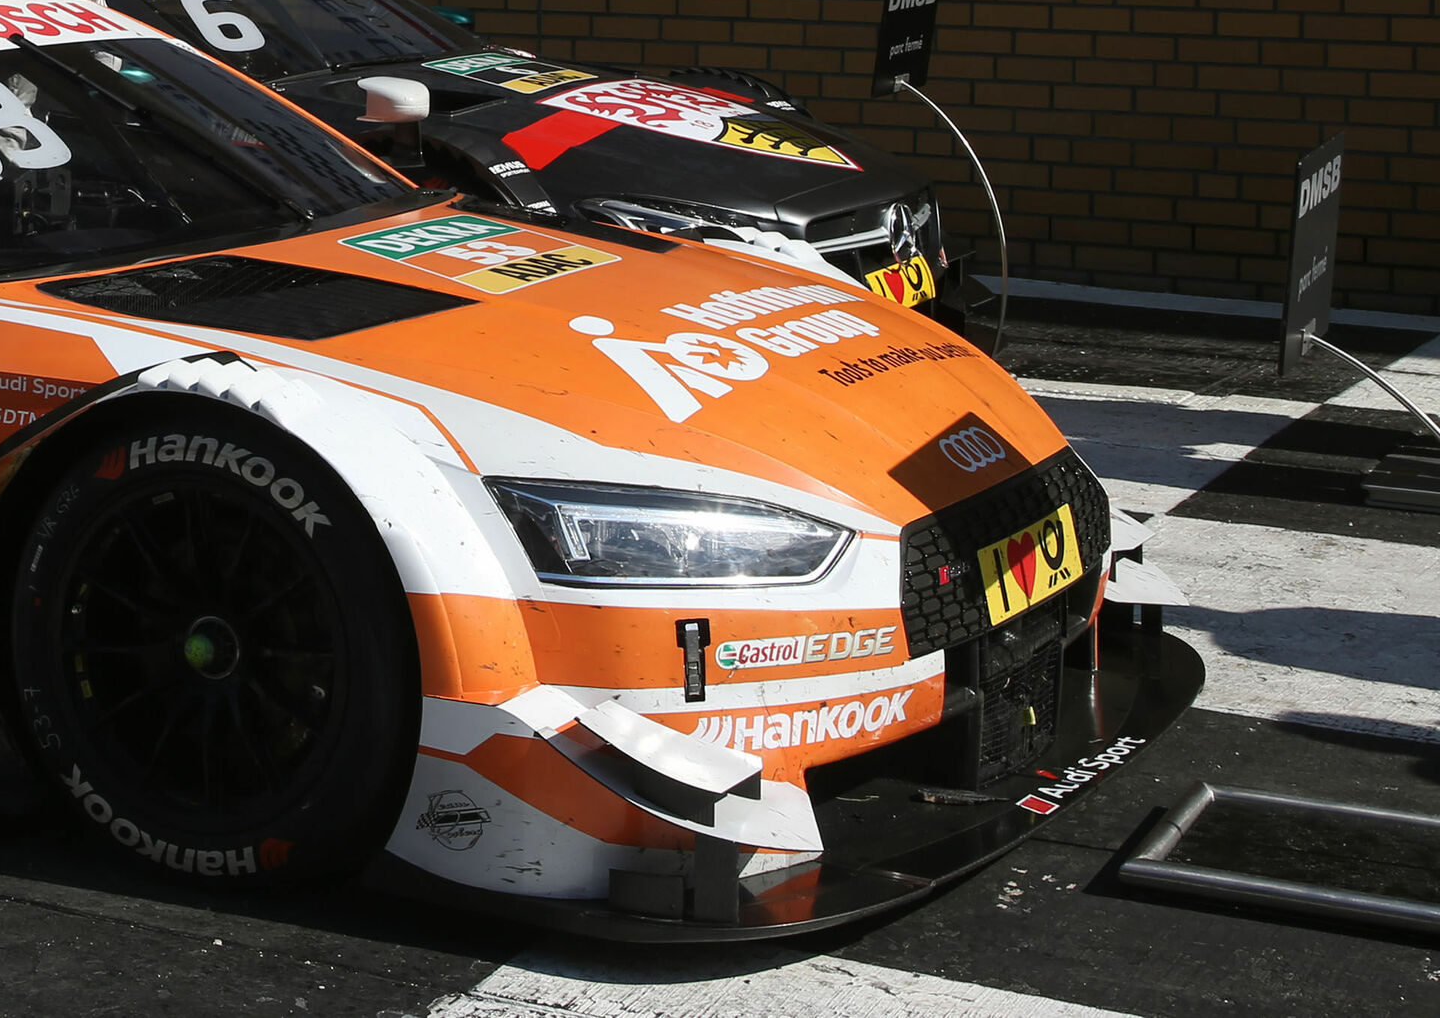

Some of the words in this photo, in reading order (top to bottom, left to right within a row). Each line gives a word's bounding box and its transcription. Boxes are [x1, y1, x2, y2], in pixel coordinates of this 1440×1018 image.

[1298, 154, 1342, 219] DMSB
[356, 221, 506, 254] DEKRA
[435, 241, 537, 265] 53
[489, 253, 593, 282] ADAC
[659, 284, 867, 331] Hoffmann
[735, 309, 881, 357] Group
[817, 360, 874, 387] Tools
[129, 432, 332, 539] Hankook
[738, 640, 799, 665] Castrol
[805, 625, 898, 664] EDGE
[733, 688, 914, 752] Hankook
[1038, 766, 1098, 799] Audi
[1078, 736, 1147, 770] Sport
[60, 763, 257, 877] Hankook
